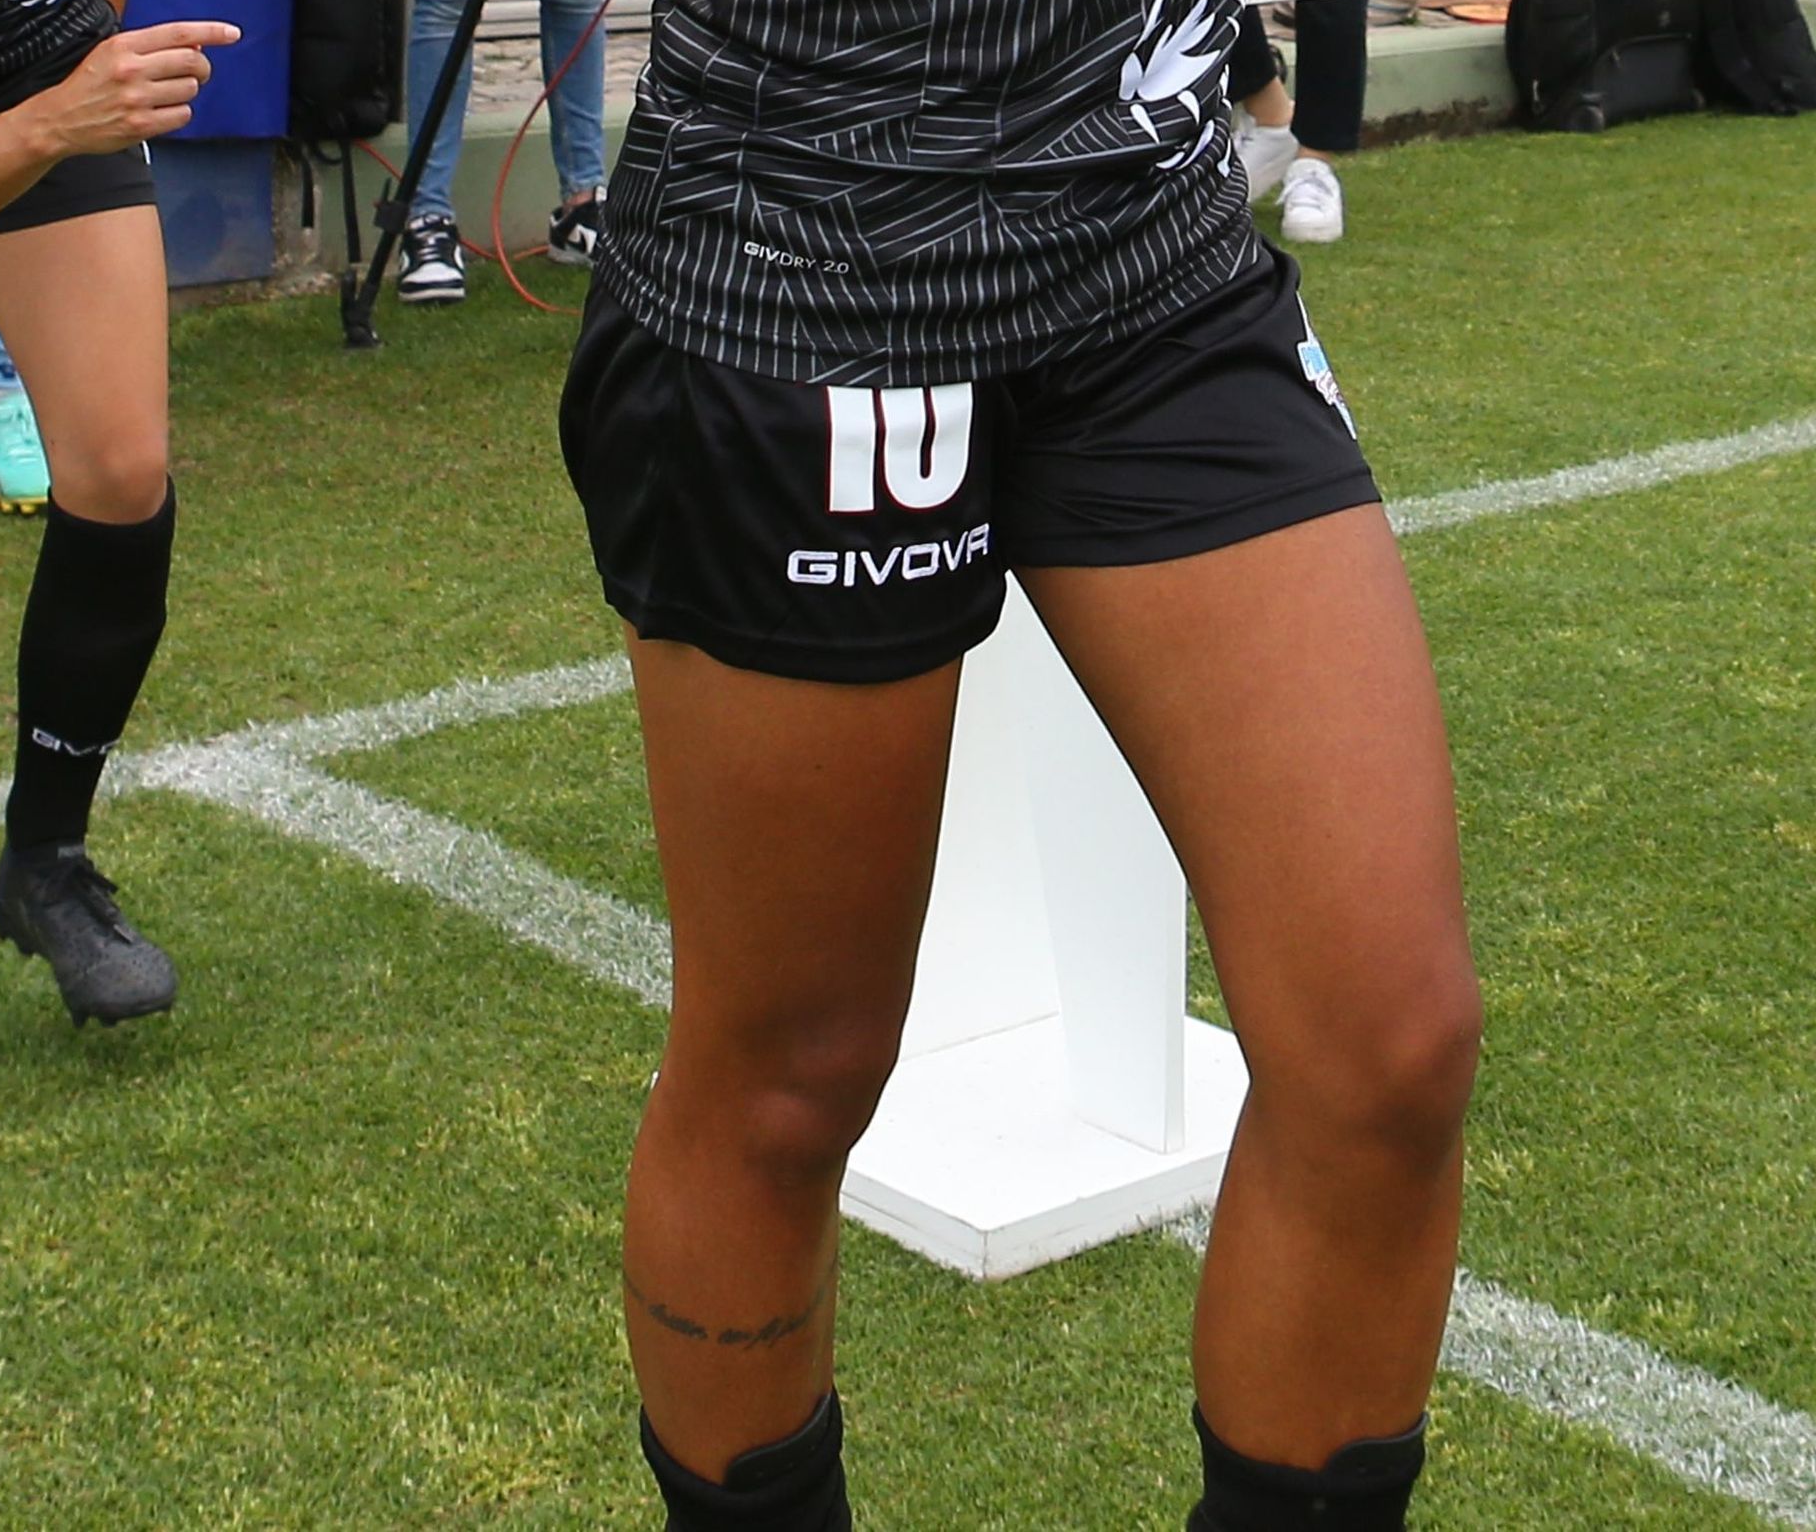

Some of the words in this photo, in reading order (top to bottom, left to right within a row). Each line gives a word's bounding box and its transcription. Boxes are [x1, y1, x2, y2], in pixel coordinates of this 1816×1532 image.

[743, 240, 816, 269] GIVDRY
[823, 259, 849, 275] 2.0
[825, 381, 973, 515] 10
[787, 522, 990, 587] GIVOVA
